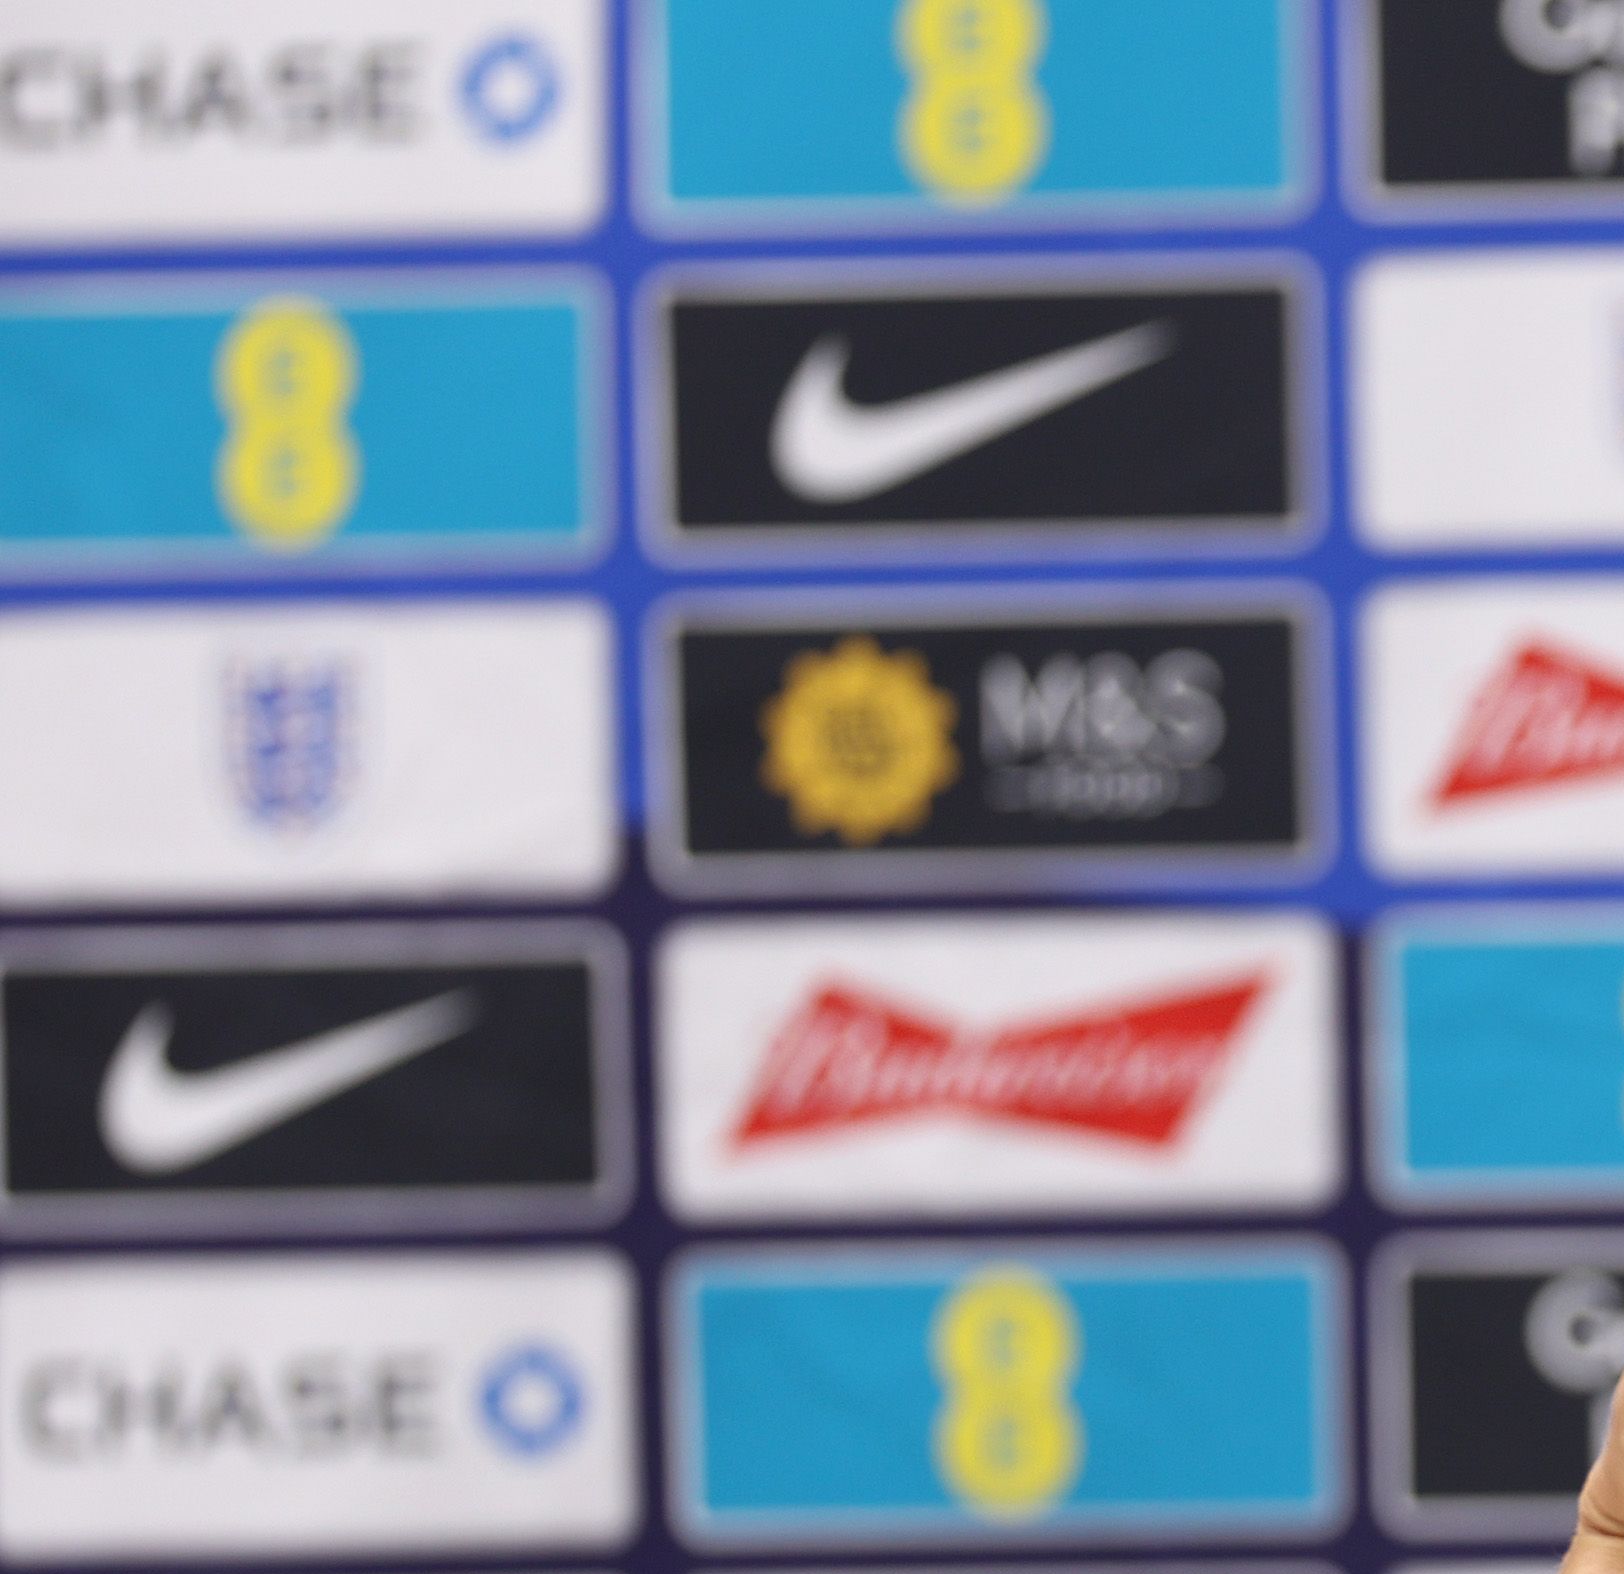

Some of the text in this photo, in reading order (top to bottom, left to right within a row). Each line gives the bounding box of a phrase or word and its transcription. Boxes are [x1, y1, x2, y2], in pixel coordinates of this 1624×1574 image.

[0, 44, 415, 152] CHASE
[980, 648, 1224, 768] M&S
[18, 1353, 440, 1460] CHASE
